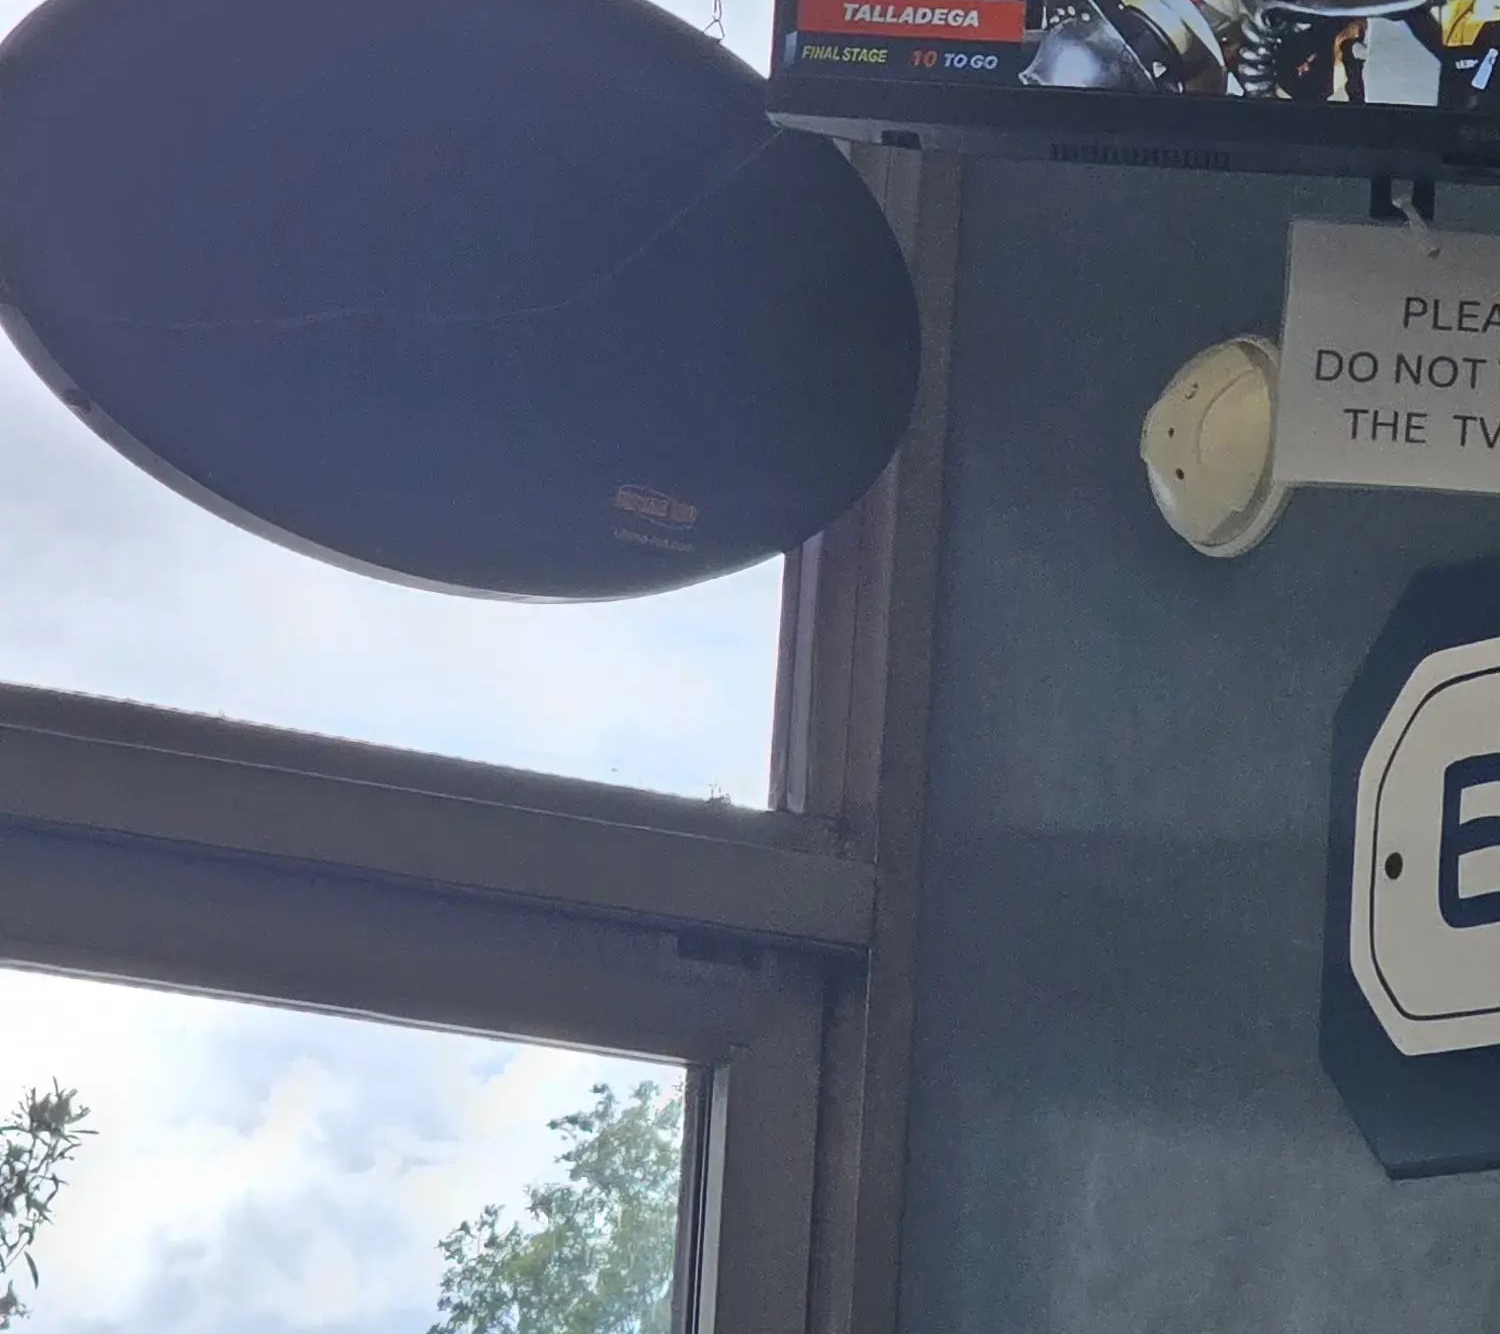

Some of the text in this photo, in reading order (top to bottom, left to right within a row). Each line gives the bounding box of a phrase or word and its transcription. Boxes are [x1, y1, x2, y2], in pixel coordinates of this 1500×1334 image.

[843, 3, 979, 27] TALLADEGA
[802, 45, 888, 63] FINAL STAGE
[912, 50, 998, 69] 10 TO GO
[1314, 349, 1379, 384] DO
[1394, 353, 1487, 390] NOT
[1343, 408, 1428, 444] THE
